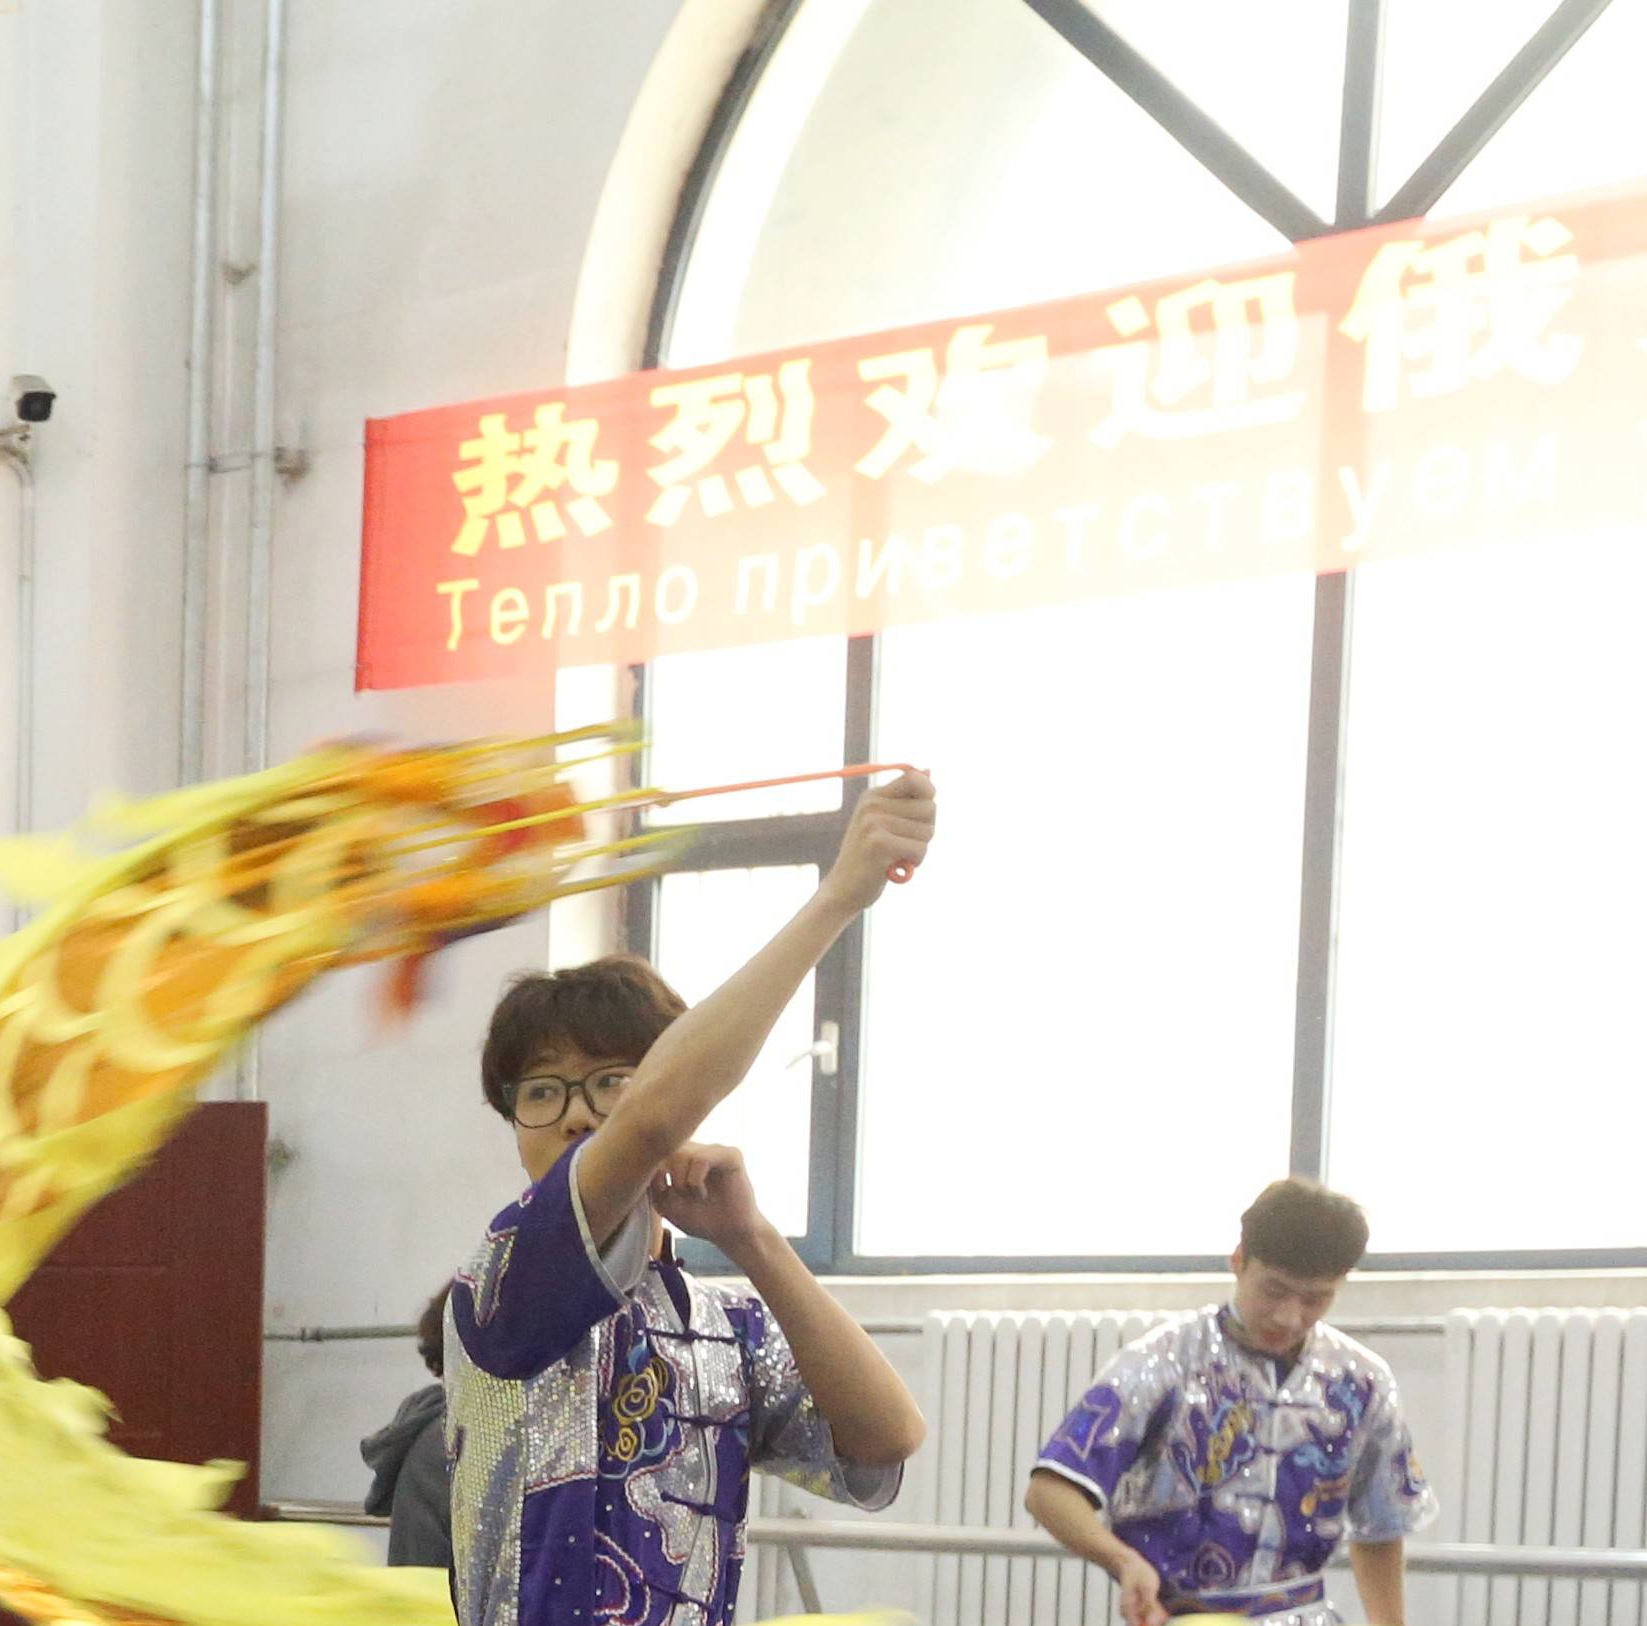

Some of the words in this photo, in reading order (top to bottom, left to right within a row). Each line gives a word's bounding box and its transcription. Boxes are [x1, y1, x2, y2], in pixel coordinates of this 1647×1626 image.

[450, 215, 1647, 557] 热烈欢迎俄
[436, 564, 699, 651] Тепло
[732, 430, 1557, 624] приветствуем
